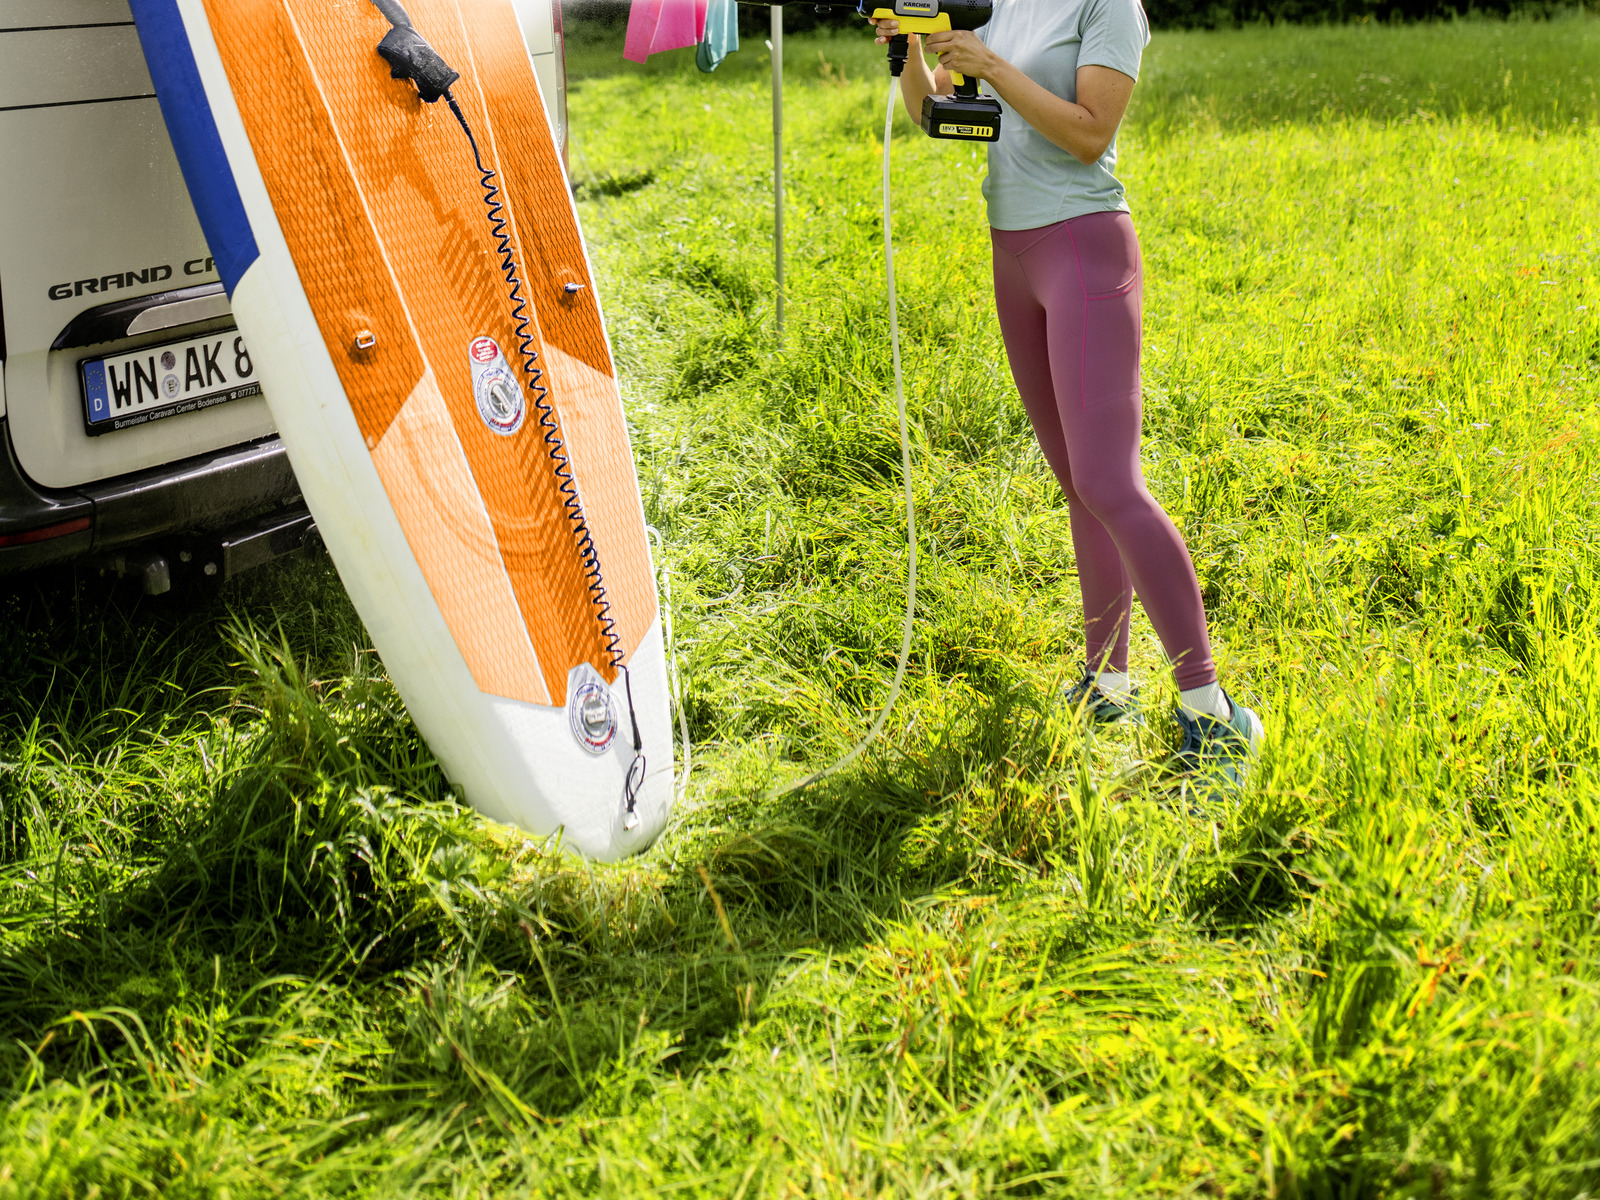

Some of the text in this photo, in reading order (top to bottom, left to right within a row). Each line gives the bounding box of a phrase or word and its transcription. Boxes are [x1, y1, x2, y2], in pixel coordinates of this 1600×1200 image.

[48, 264, 173, 301] GRAND
[108, 335, 254, 409] WN AK 8
[94, 398, 103, 412] D
[114, 414, 149, 429] Burmeister
[149, 408, 175, 420] Caravan
[176, 402, 197, 413] Center
[197, 395, 227, 408] Bodensee
